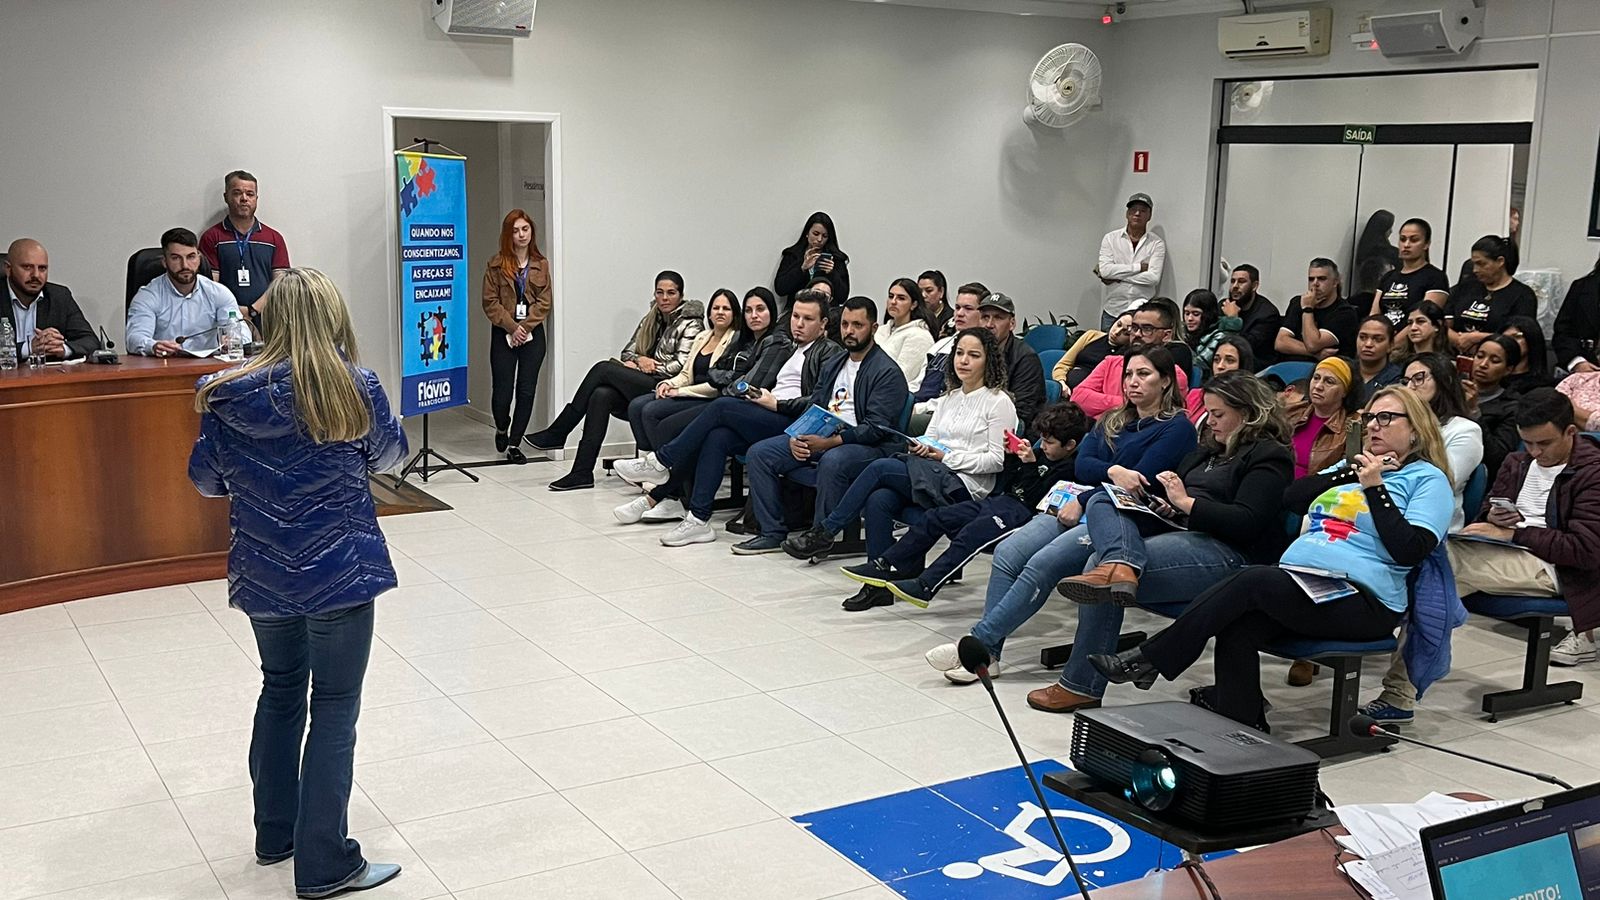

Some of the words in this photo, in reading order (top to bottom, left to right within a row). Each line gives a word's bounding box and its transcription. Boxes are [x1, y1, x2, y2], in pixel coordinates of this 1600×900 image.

[1345, 128, 1372, 141] SAÍDA
[411, 228, 440, 238] QUANDO
[441, 228, 453, 237] NOS
[403, 248, 460, 258] CONSCIENTIZAMOS,
[413, 269, 421, 279] AS
[422, 268, 444, 279] PEÇAS
[445, 268, 453, 277] SE
[415, 288, 451, 299] ENCAIXAM!
[1509, 883, 1561, 900] DITO!
